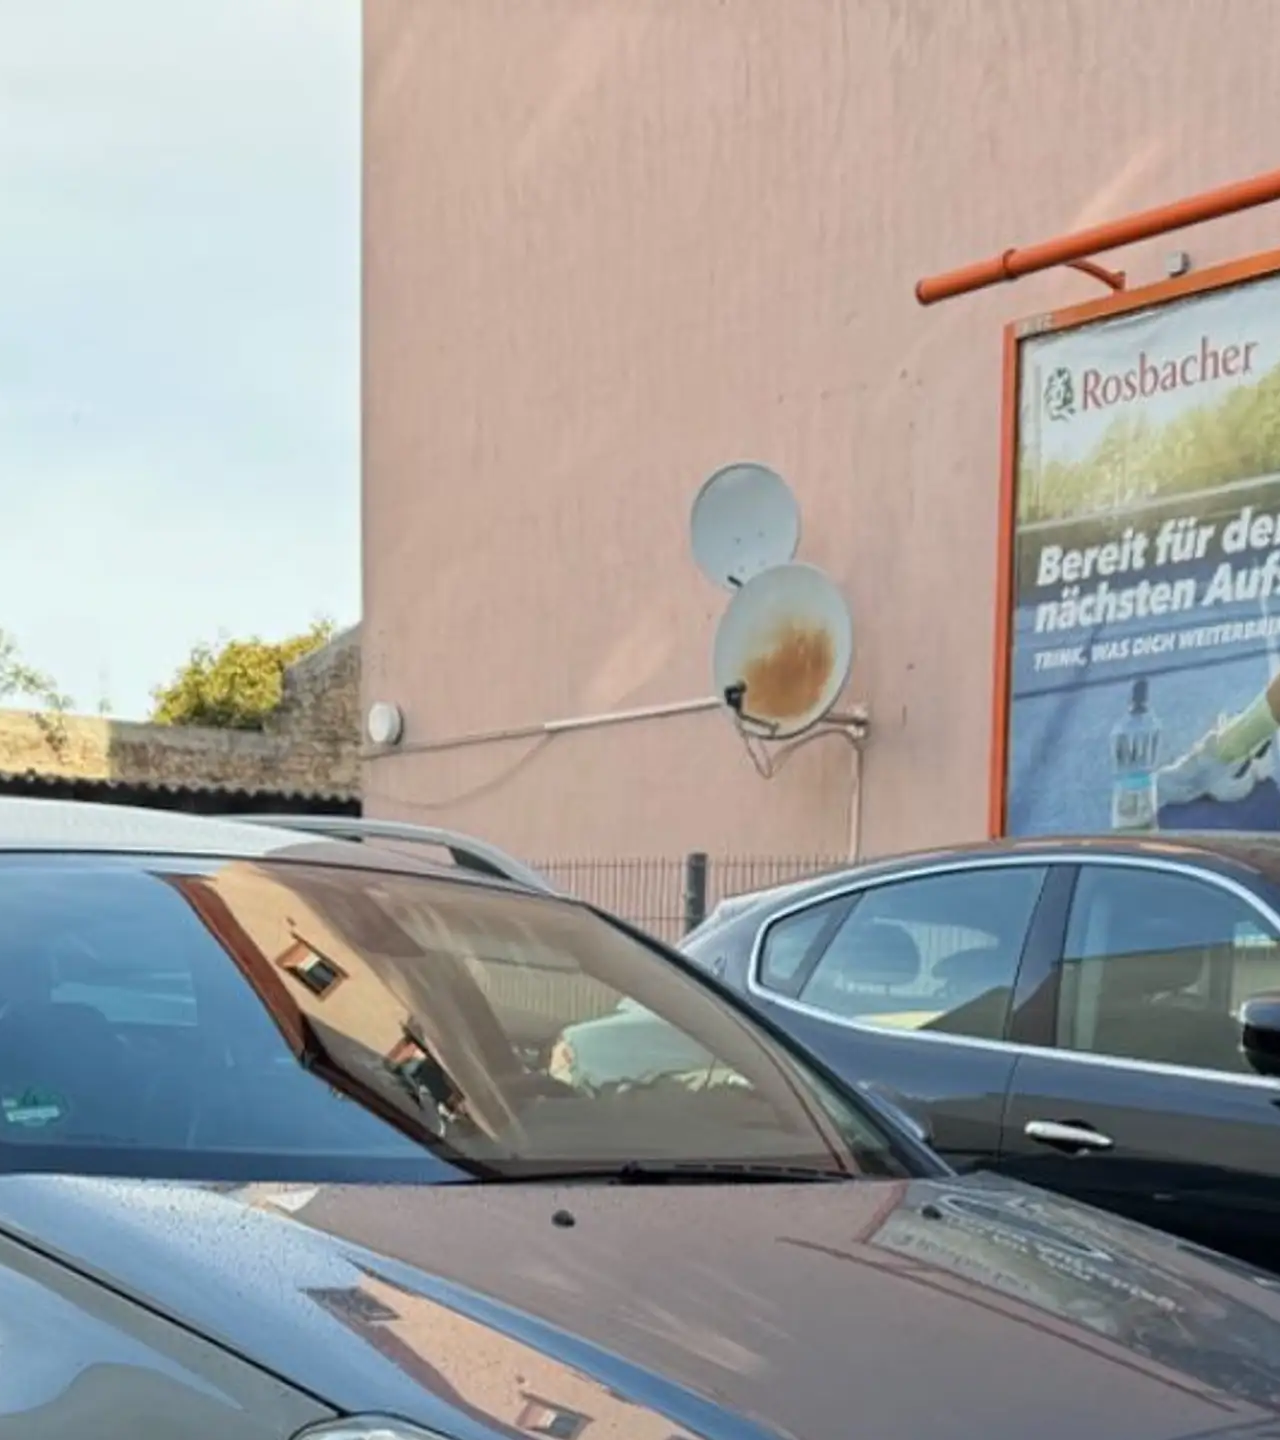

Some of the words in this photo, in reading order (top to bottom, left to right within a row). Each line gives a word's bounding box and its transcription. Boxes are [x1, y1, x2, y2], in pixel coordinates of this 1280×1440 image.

[1081, 336, 1260, 412] Rosbacher
[1036, 526, 1148, 588] Bereit
[1155, 515, 1213, 565] für
[1034, 575, 1198, 633] nächsten
[1033, 650, 1088, 672] TRINK,
[1090, 640, 1131, 664] WAS
[1132, 633, 1176, 657] DICH
